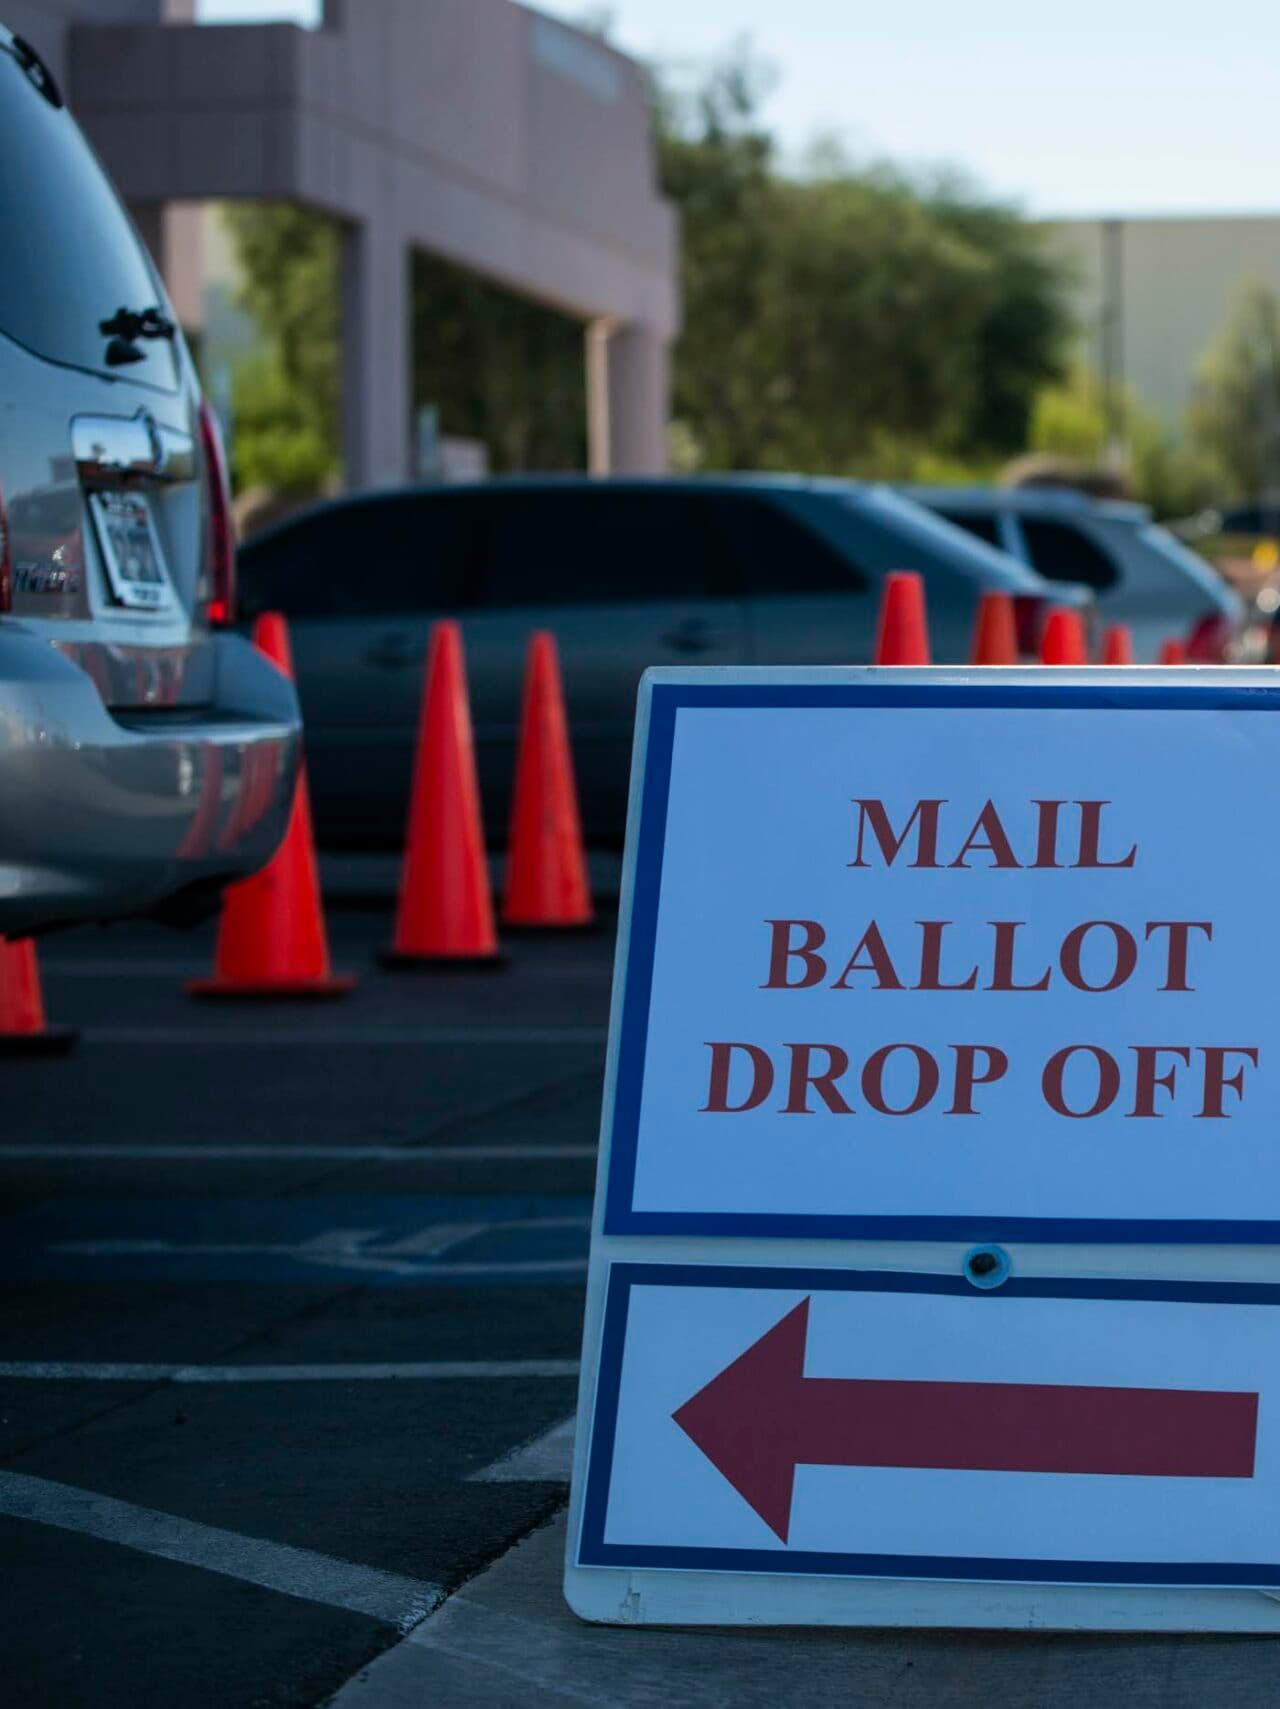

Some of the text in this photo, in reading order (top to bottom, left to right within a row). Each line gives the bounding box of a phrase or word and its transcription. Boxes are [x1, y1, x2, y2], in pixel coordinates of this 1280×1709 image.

[847, 799, 1138, 869] MAIL
[759, 919, 1213, 993] BALLOT
[698, 1041, 1260, 1119] DROP OFF
